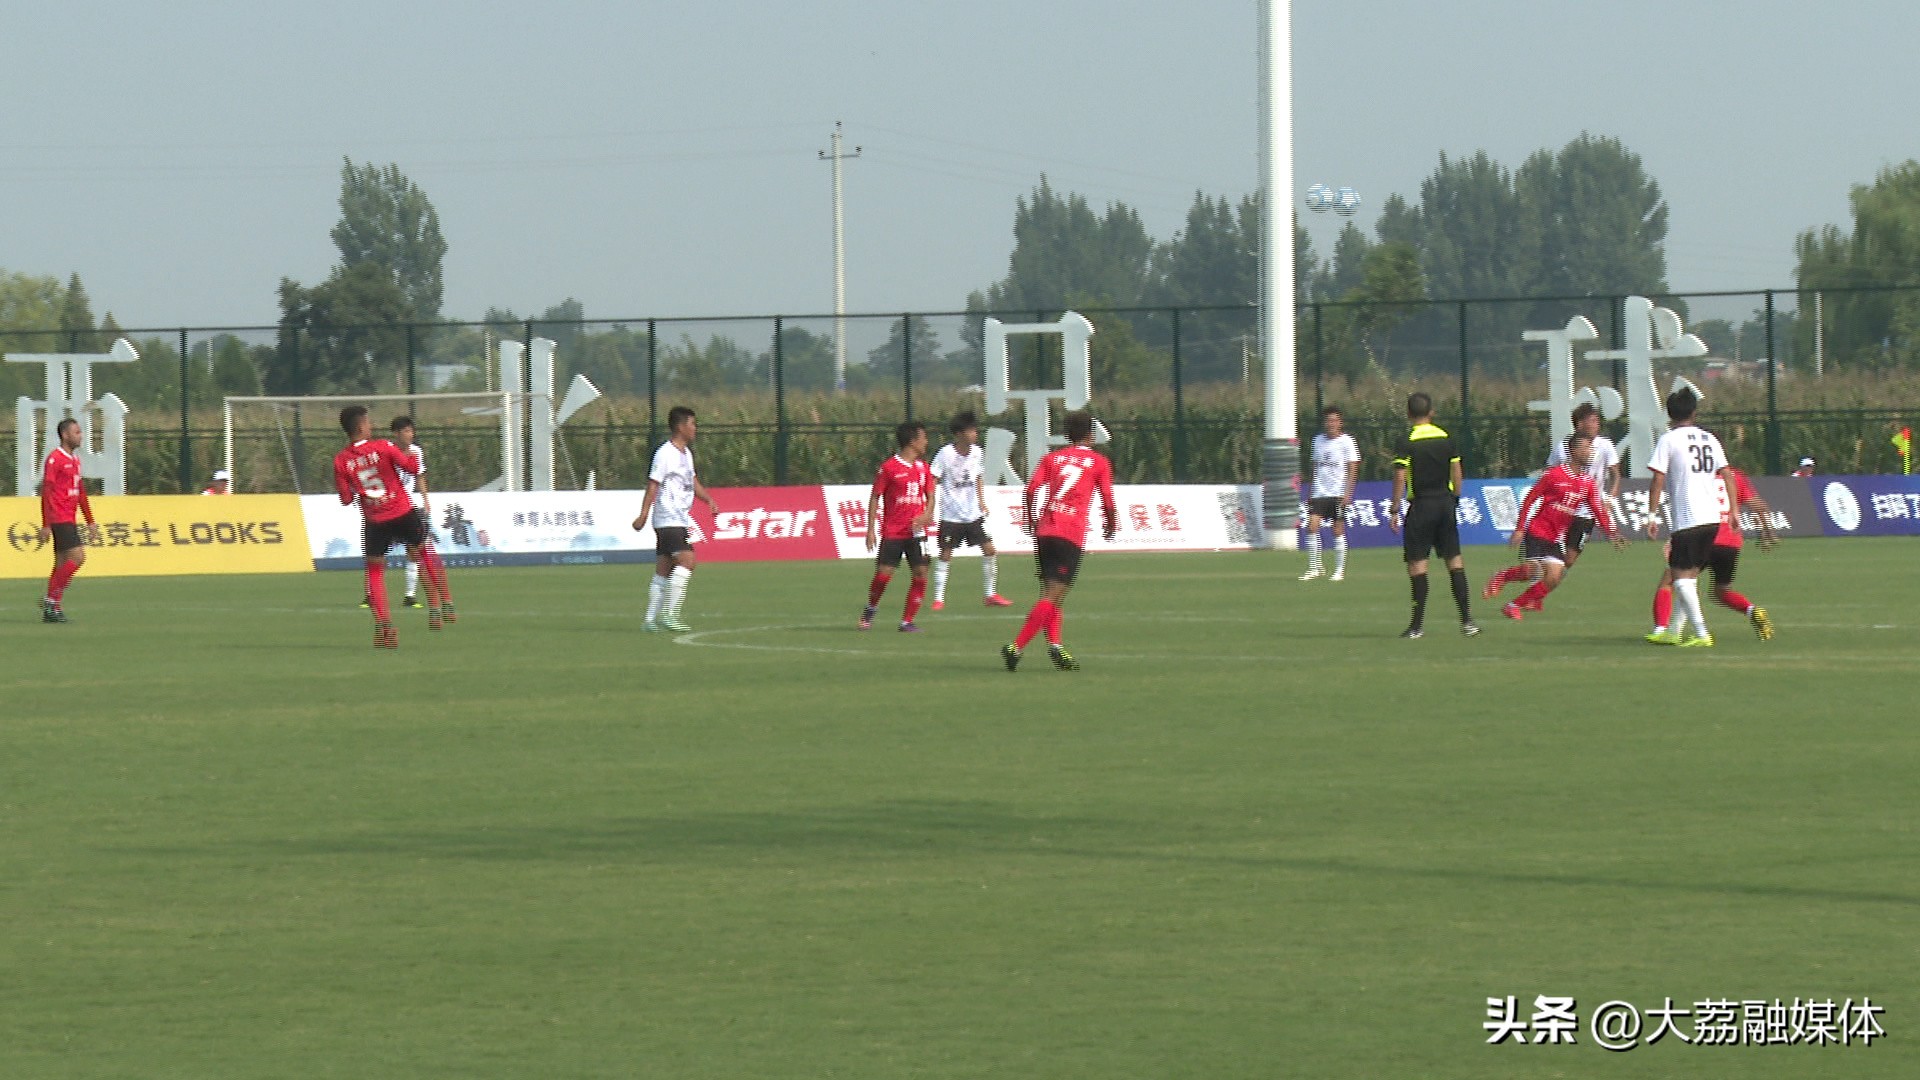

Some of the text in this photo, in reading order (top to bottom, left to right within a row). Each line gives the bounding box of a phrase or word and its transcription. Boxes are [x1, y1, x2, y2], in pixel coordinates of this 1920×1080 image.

[1688, 444, 1715, 473] 36
[357, 467, 387, 497] 5
[1053, 464, 1083, 501] 7
[169, 521, 283, 546] LOOKS
[712, 506, 818, 540] star
